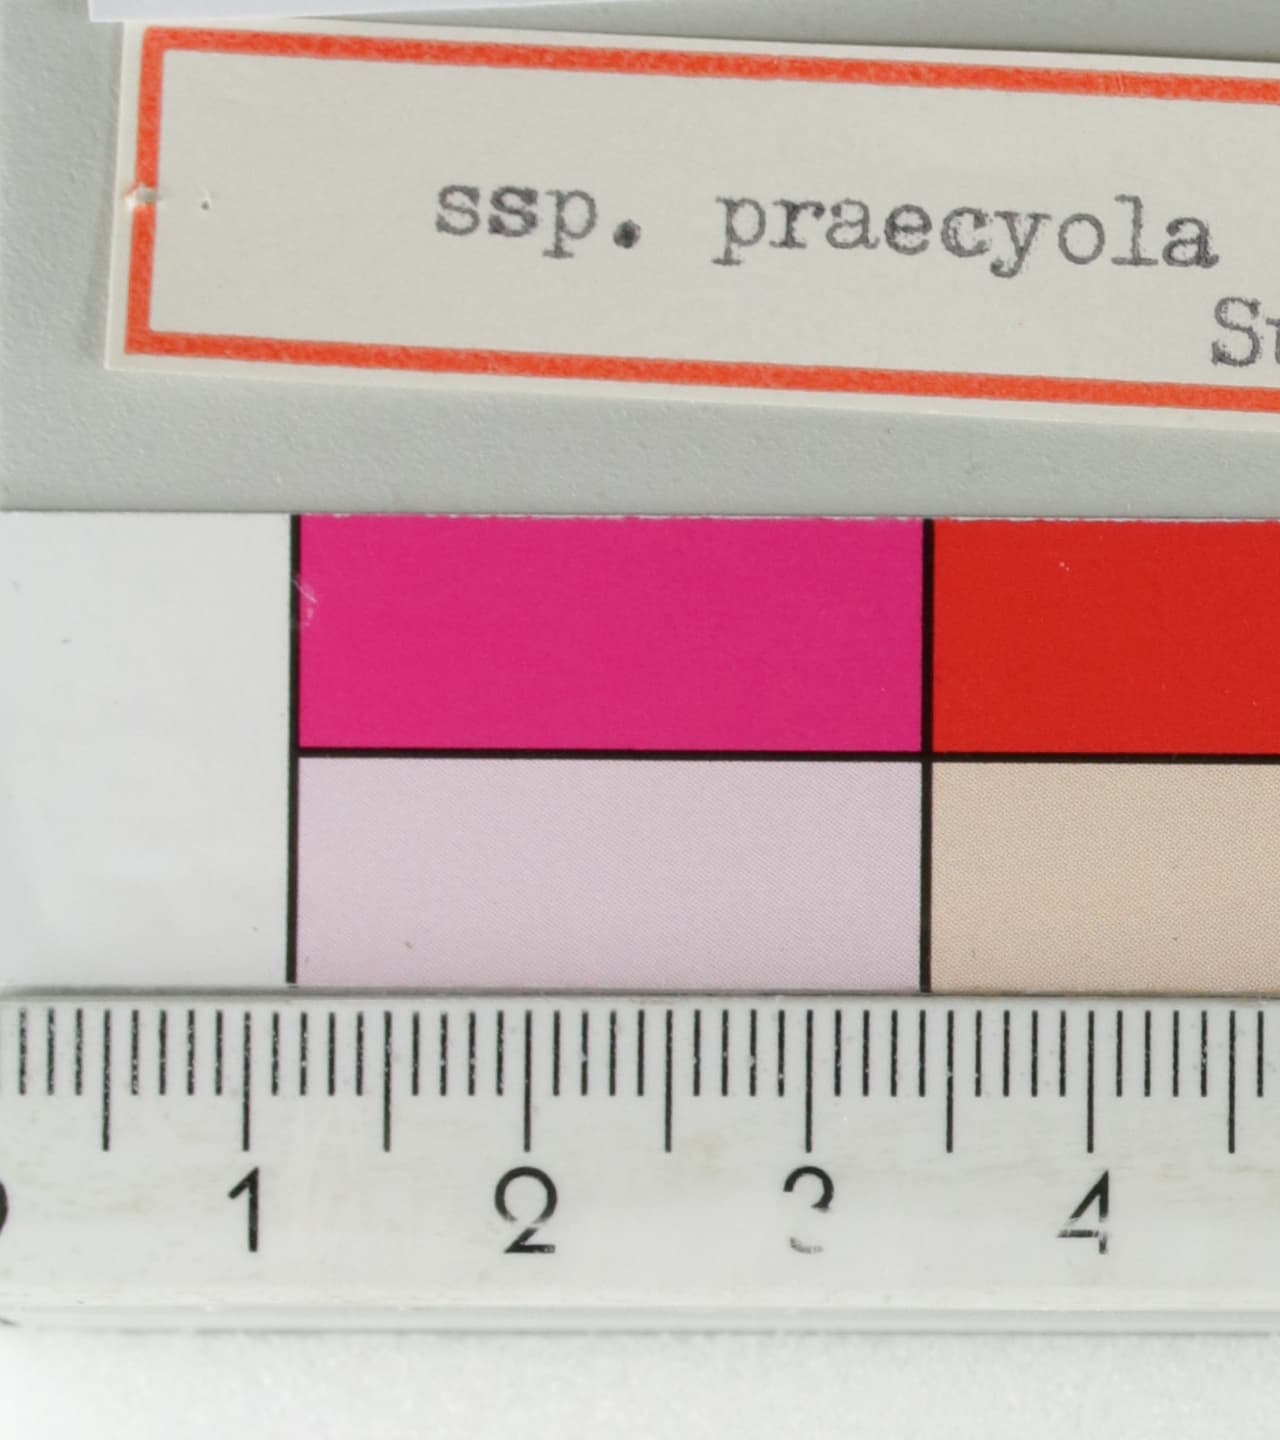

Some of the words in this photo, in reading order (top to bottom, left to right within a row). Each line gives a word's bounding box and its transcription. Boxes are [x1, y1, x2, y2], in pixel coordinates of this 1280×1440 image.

[434, 183, 642, 261] ssp.
[710, 192, 1221, 280] praecyola
[226, 1165, 261, 1254] 1
[492, 1164, 560, 1256] 2
[1057, 1168, 1111, 1256] 4
